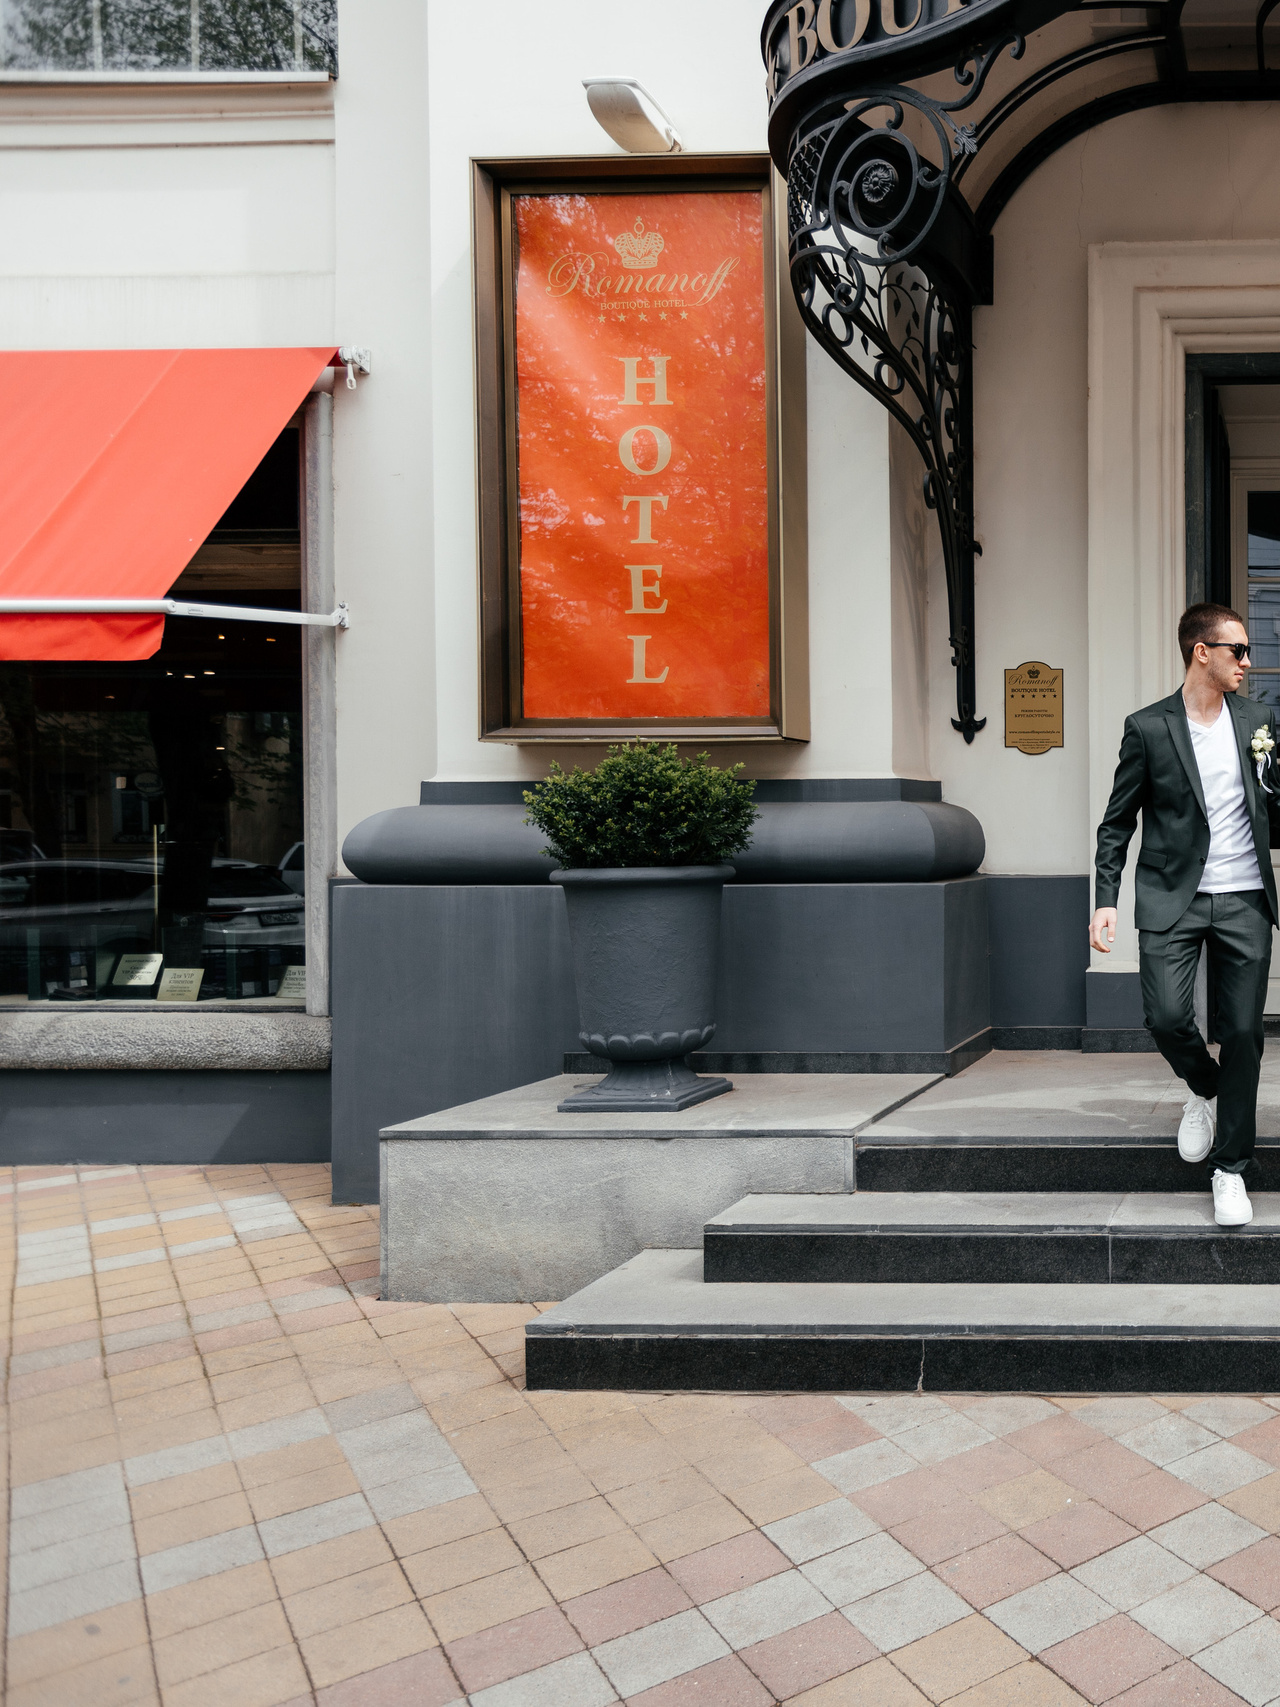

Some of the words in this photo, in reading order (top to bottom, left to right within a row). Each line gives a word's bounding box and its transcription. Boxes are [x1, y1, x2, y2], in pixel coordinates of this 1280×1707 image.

[784, 0, 968, 81] BOU
[545, 252, 741, 306] Romanoff
[600, 300, 650, 311] BOUTIQUE
[654, 299, 688, 308] HOTEL
[618, 356, 673, 684] HOTEL
[1008, 674, 1059, 688] Romanoff
